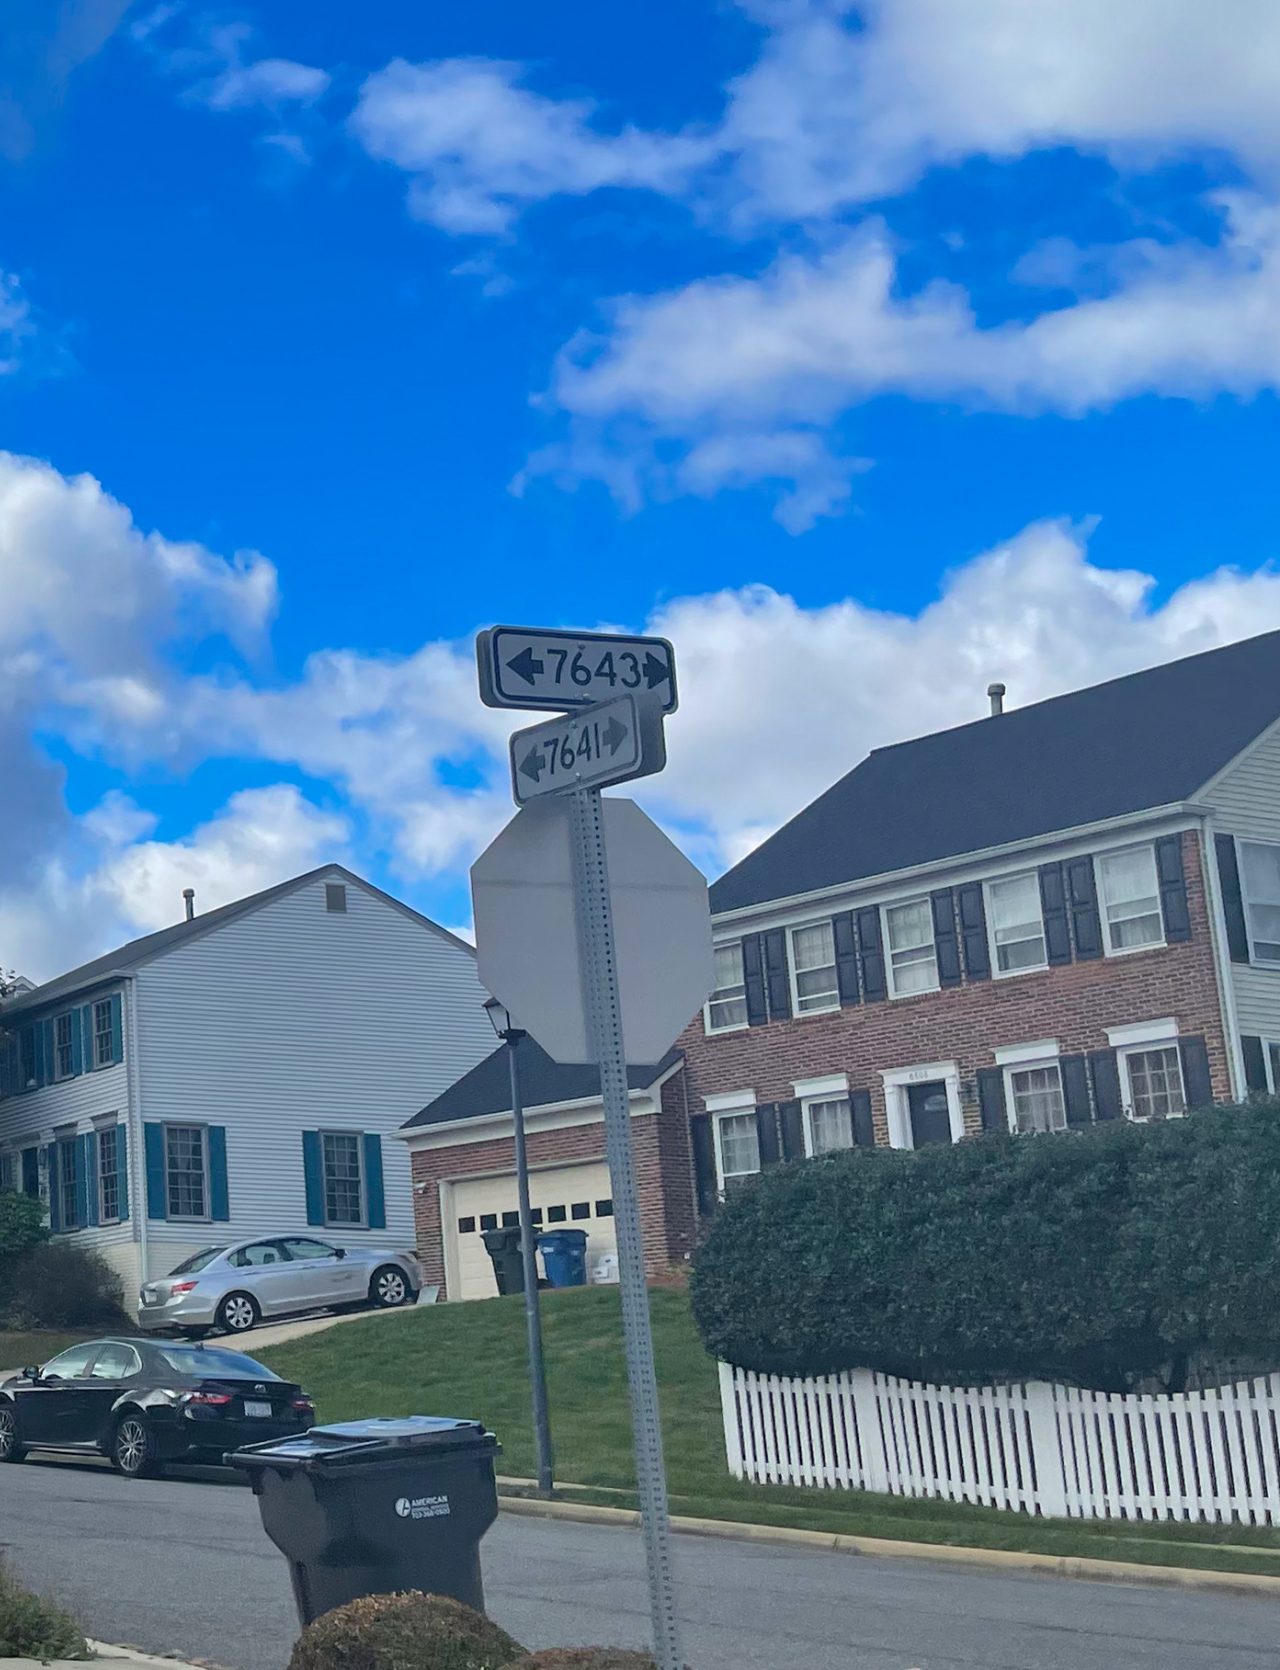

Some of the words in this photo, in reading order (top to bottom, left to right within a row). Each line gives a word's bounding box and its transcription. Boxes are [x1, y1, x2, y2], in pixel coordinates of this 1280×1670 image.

[546, 648, 642, 689] 7643
[543, 722, 601, 775] 7641
[411, 1495, 449, 1507] AMERICAN
